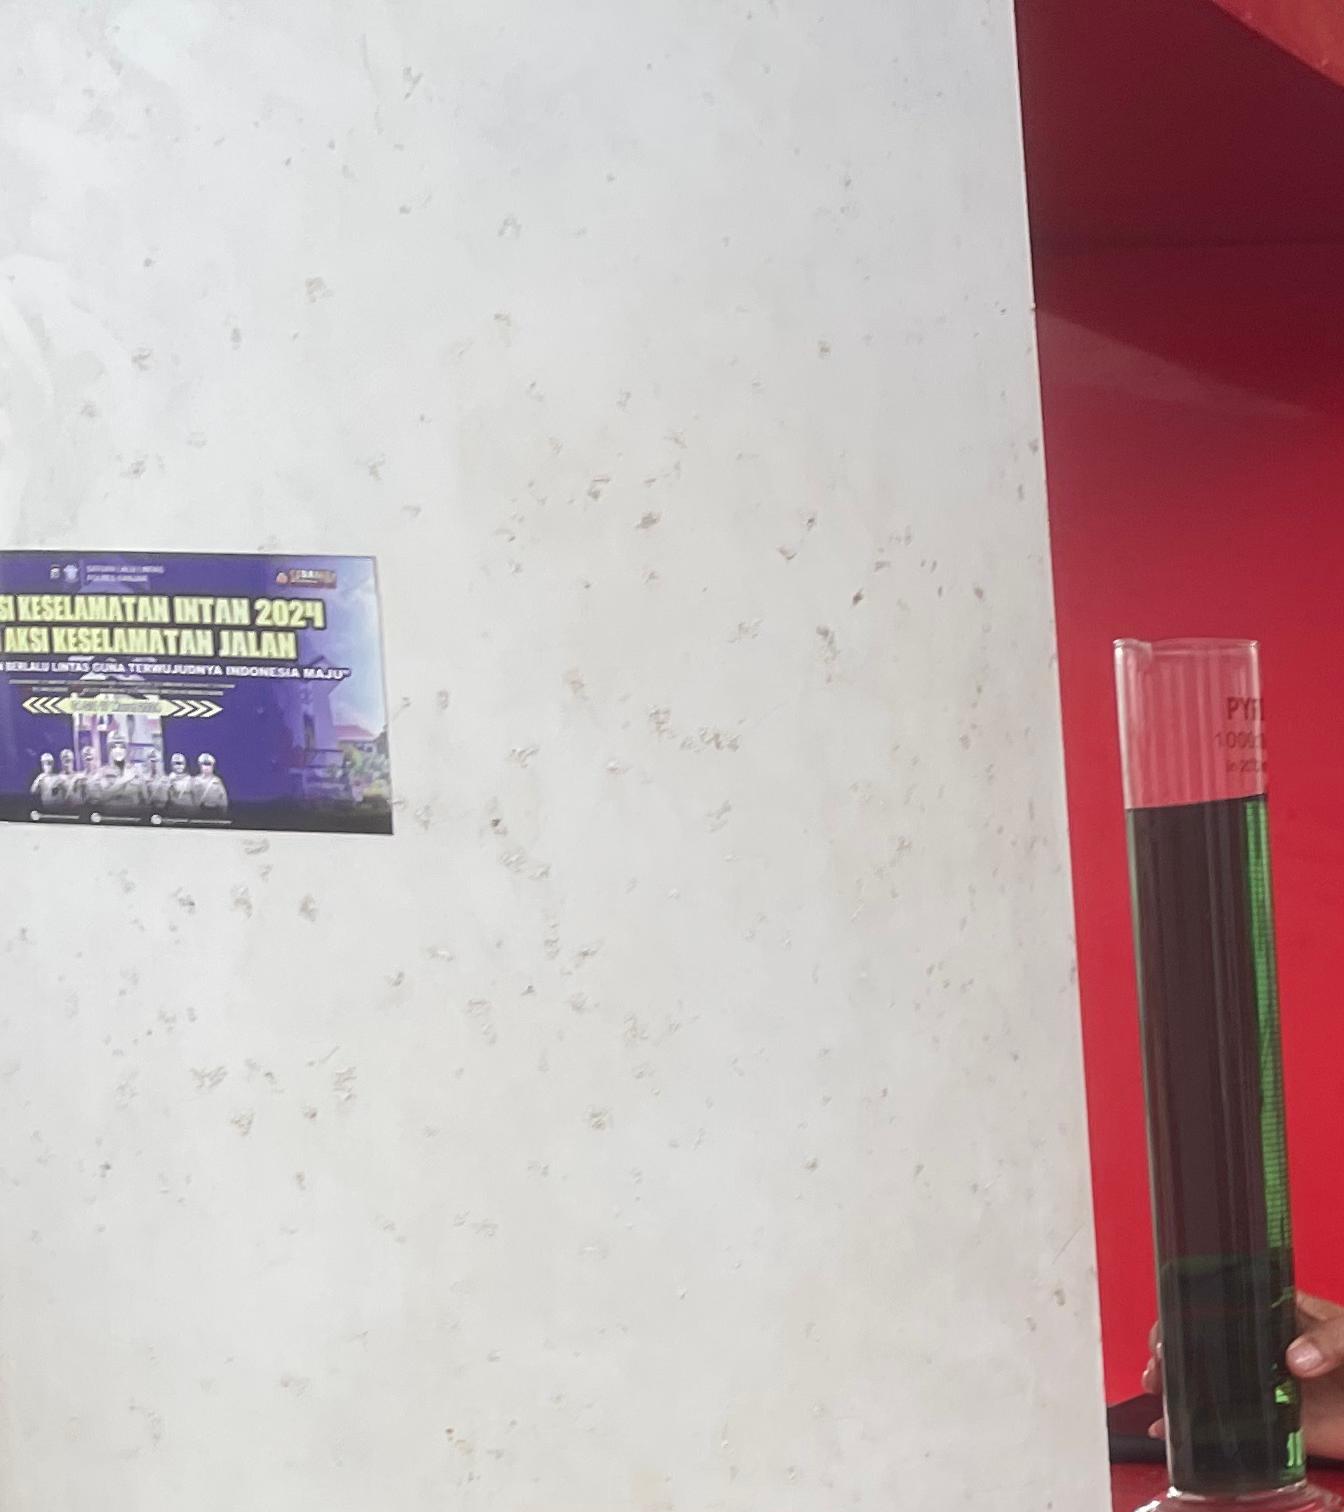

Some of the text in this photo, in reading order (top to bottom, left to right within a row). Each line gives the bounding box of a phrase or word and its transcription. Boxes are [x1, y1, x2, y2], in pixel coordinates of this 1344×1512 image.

[16, 594, 170, 623] KESELAMATAN
[254, 598, 326, 629] 2024
[4, 626, 298, 660] AKSI KESELAMATAN JALAN
[127, 663, 223, 676] TERWUJUDNYA
[226, 665, 299, 679] INDONESIA
